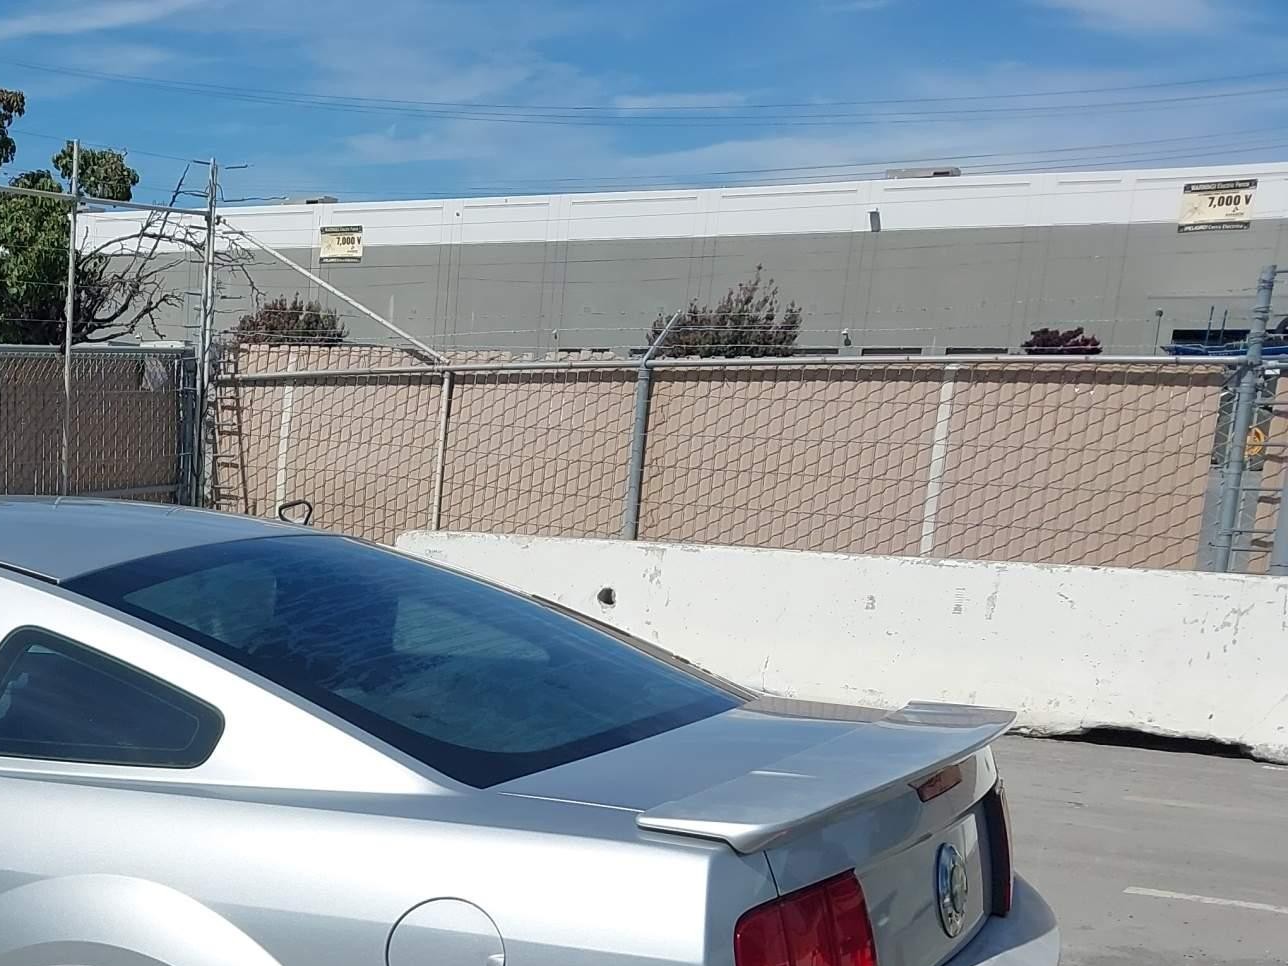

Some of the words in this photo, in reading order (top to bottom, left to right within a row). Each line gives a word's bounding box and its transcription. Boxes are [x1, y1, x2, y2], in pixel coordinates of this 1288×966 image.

[1208, 194, 1241, 208] 7,000
[1244, 194, 1253, 205] V
[336, 236, 355, 246] 7,000
[357, 236, 362, 244] V
